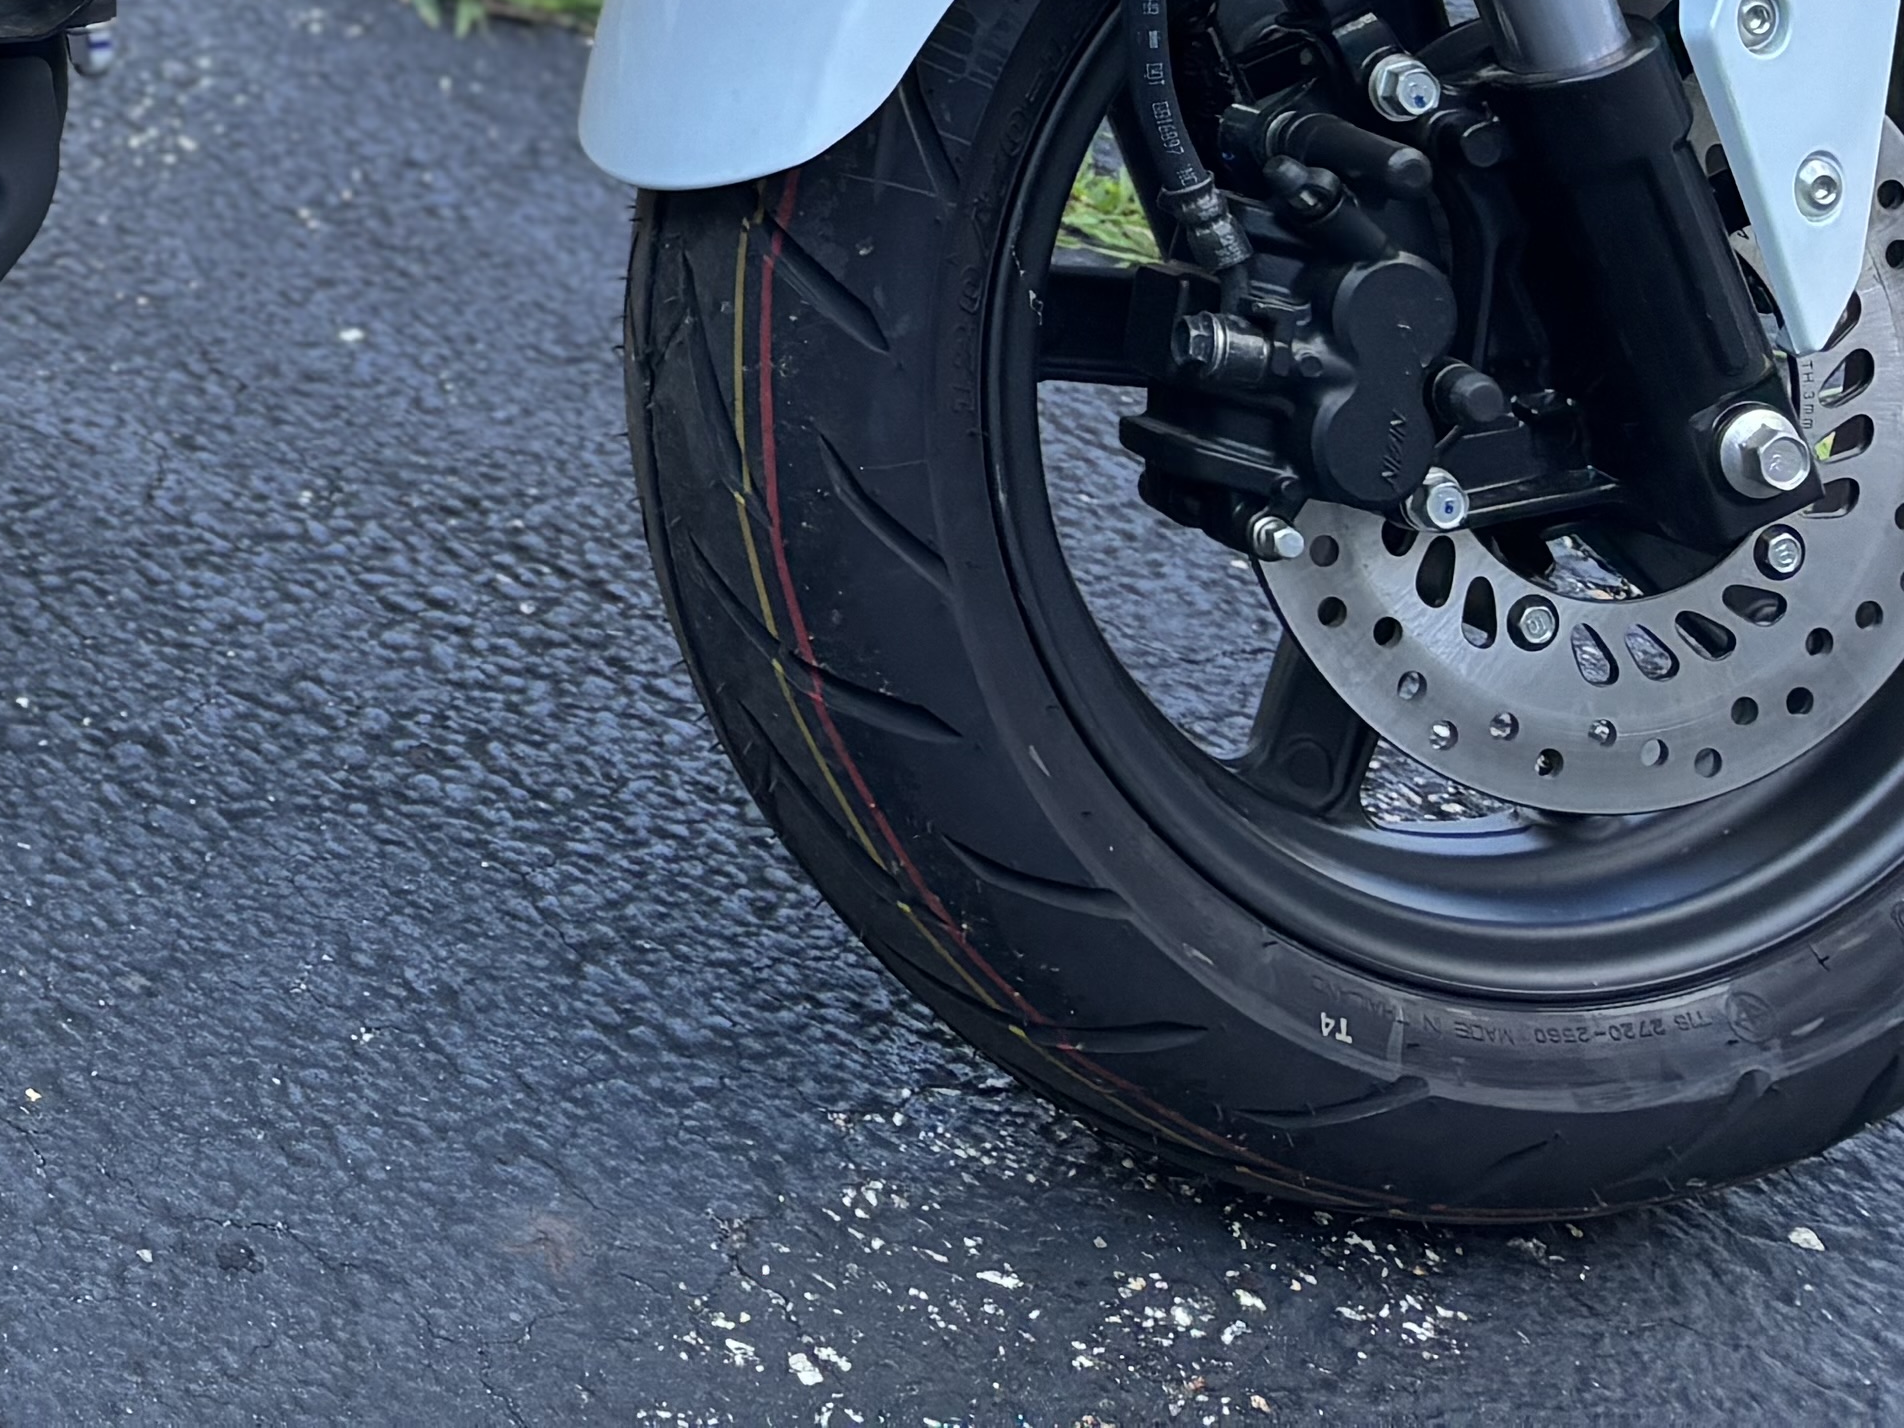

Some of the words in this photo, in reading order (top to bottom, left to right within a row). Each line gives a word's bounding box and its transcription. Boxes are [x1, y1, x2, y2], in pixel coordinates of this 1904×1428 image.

[1319, 1011, 1354, 1044] T4
[1454, 1020, 1516, 1046] MADE
[1533, 1017, 1667, 1045] 2720-2560
